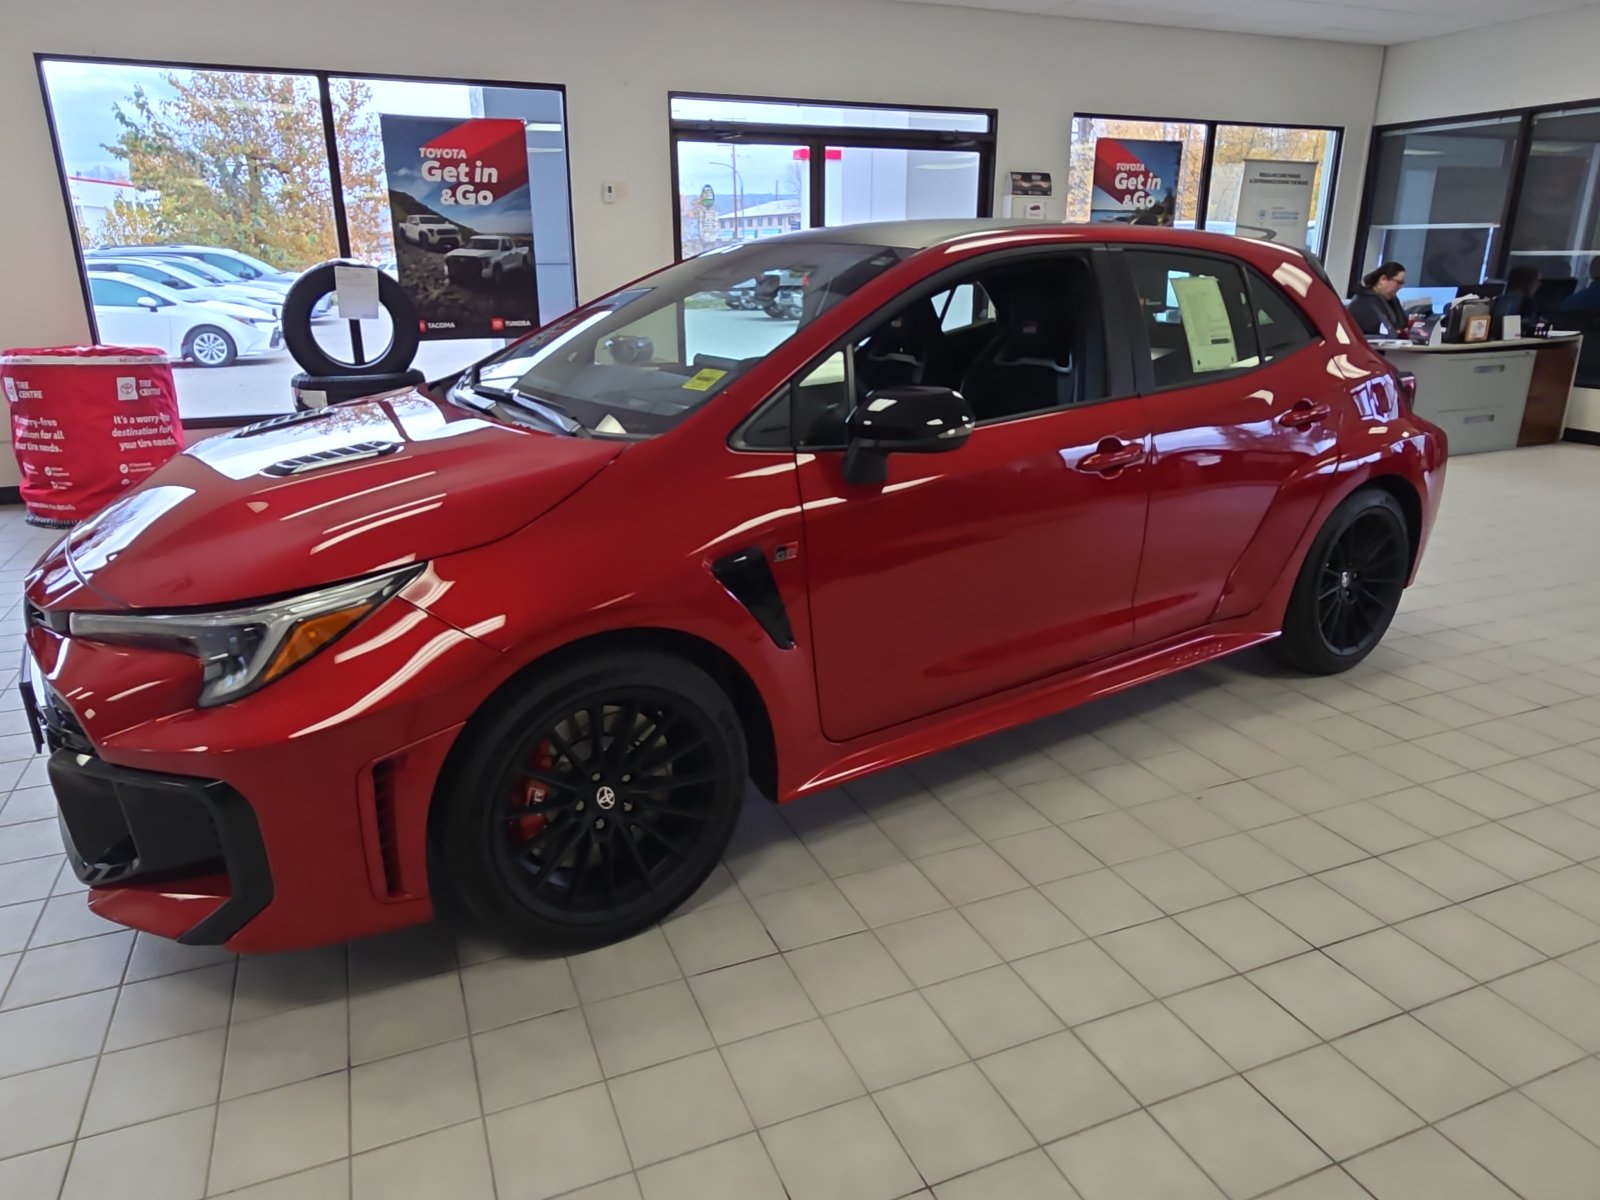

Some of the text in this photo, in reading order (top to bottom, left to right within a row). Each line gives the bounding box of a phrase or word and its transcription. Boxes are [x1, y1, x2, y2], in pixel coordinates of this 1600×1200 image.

[419, 147, 467, 159] TOYOTA
[421, 160, 499, 183] Get in
[1116, 163, 1145, 171] TOYOTA
[1115, 171, 1162, 190] Get in
[111, 427, 158, 437] destination
